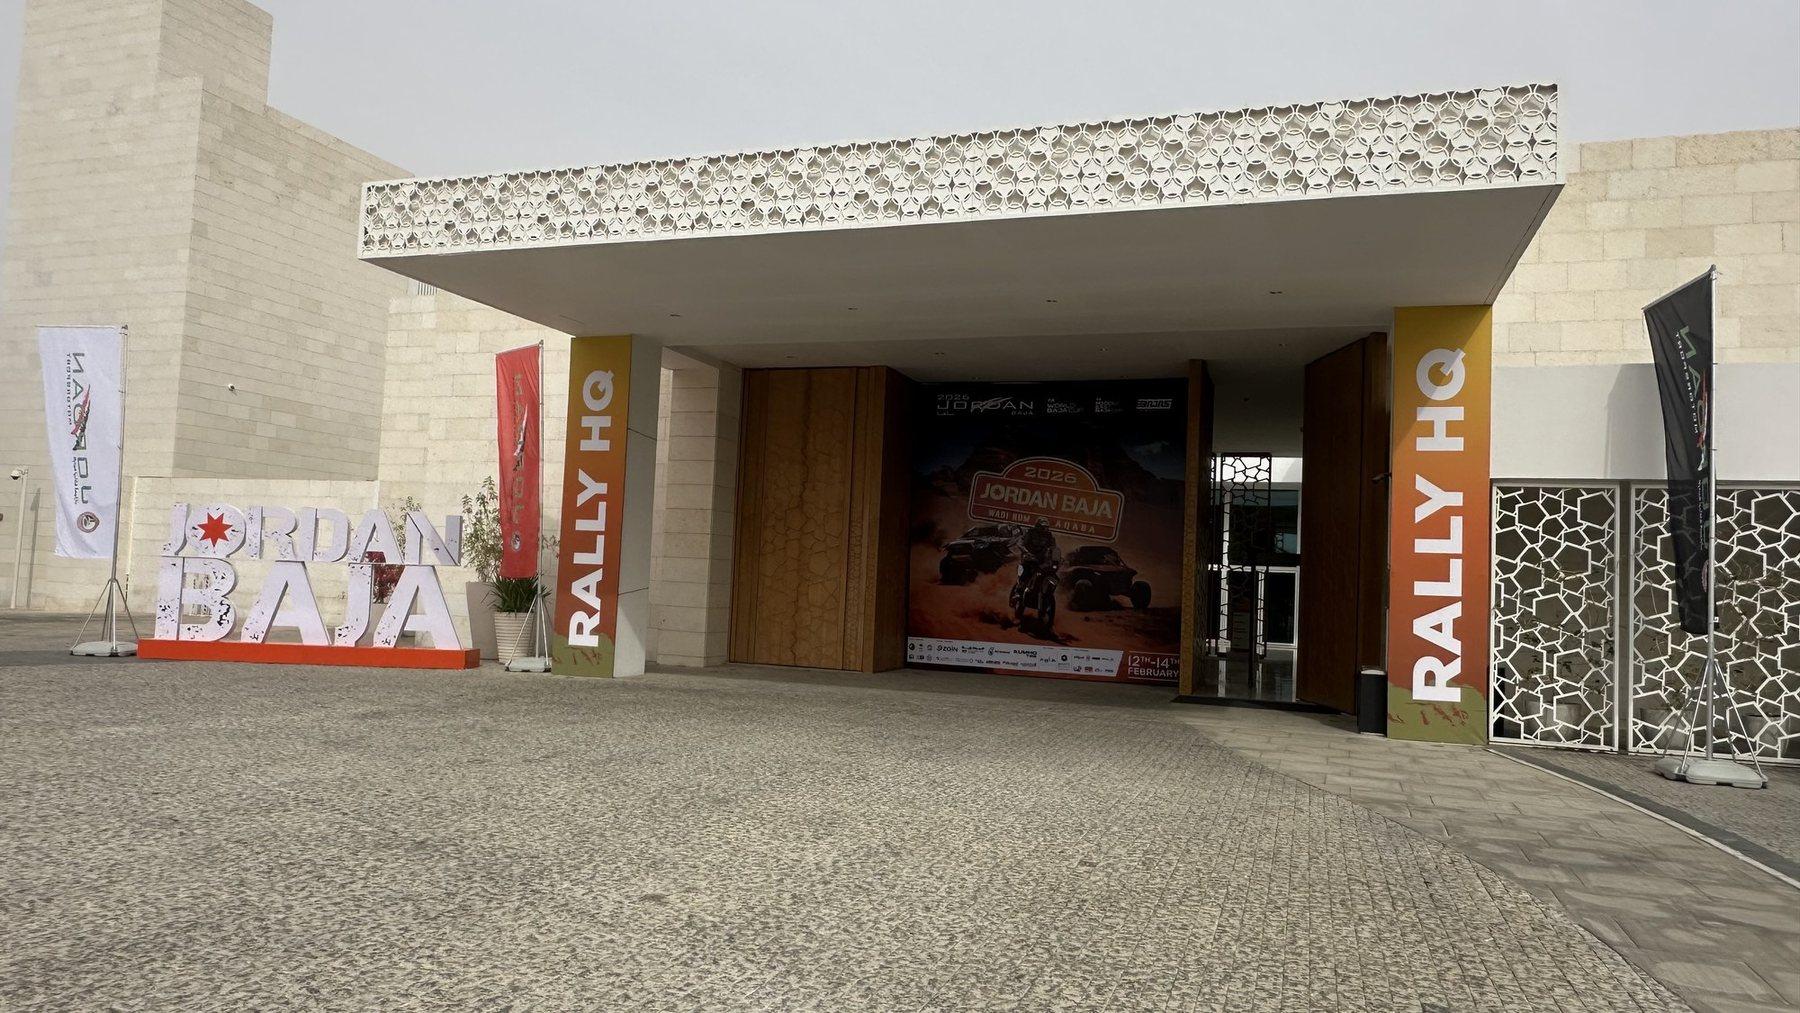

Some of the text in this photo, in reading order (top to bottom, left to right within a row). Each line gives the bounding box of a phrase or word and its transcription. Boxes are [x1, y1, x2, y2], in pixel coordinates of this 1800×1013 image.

[937, 399, 1034, 413] JORDAN
[1023, 465, 1078, 484] 2026
[568, 369, 615, 647] RALLY HQ
[979, 482, 1113, 519] JORDAN BAJA
[1412, 348, 1466, 703] RALLY HQ
[160, 502, 462, 567] JORDAN
[153, 556, 464, 650] BAJA
[1128, 667, 1179, 677] FEBRUARY
